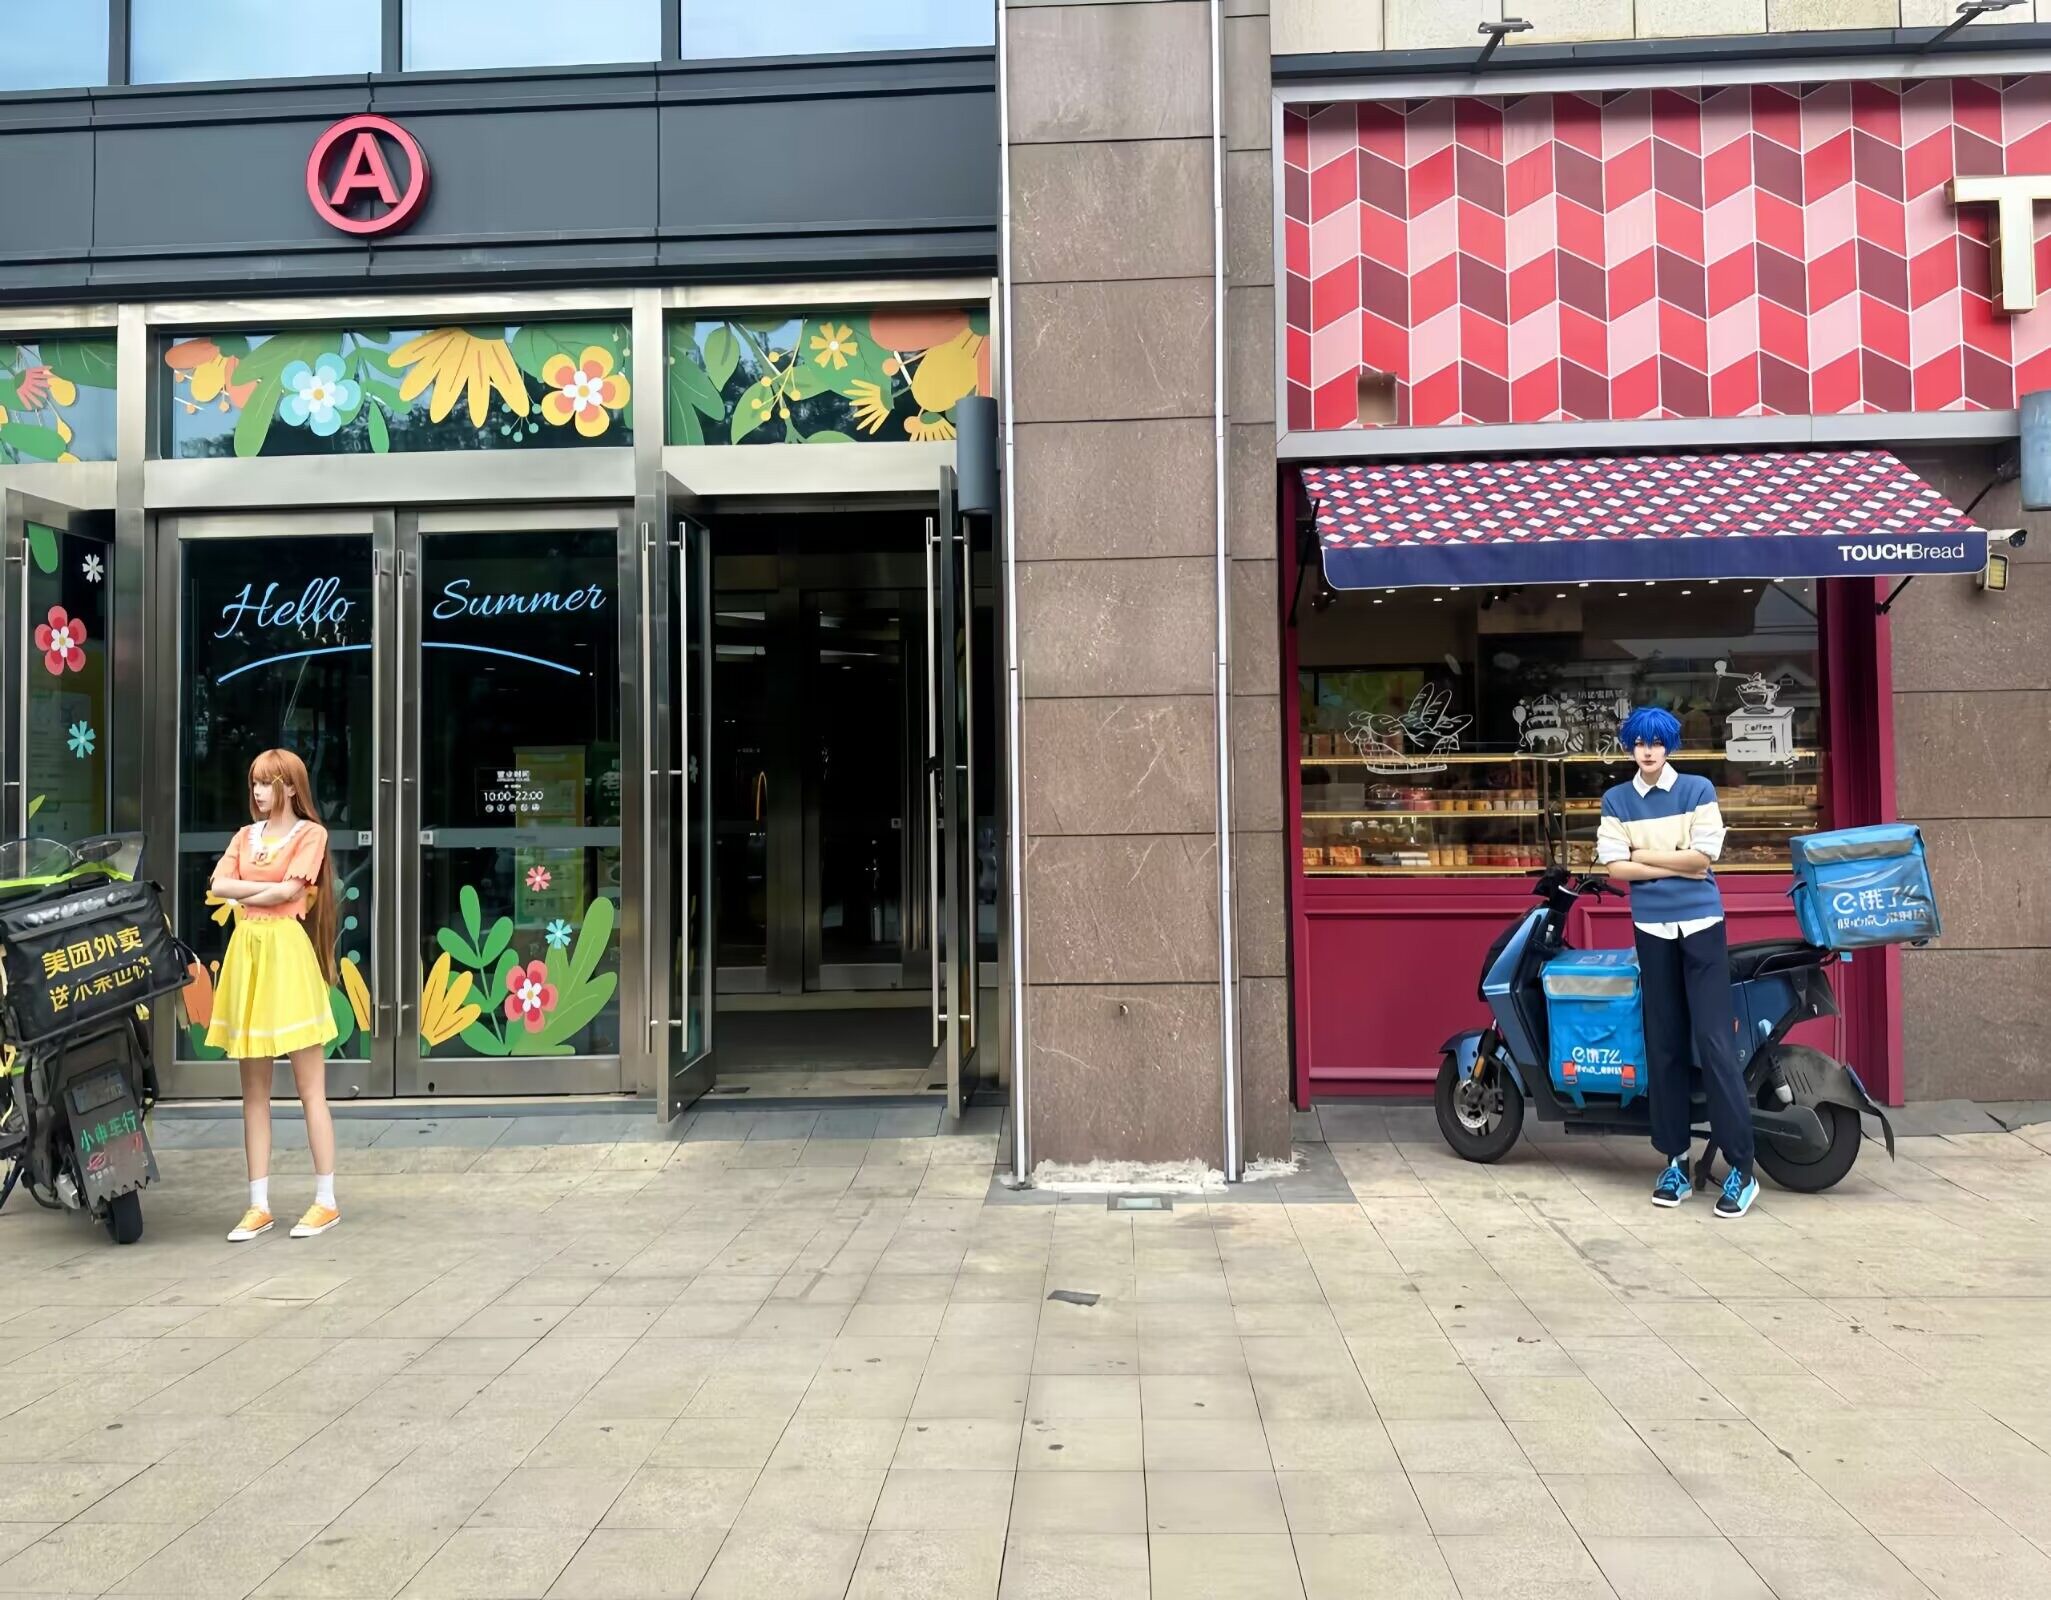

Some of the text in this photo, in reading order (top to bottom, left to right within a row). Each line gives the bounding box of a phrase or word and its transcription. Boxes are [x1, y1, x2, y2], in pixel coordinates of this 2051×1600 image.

[330, 132, 401, 206] A
[1945, 174, 2051, 316] T
[213, 576, 607, 639] Hello Summer
[41, 926, 144, 980] 美团外卖
